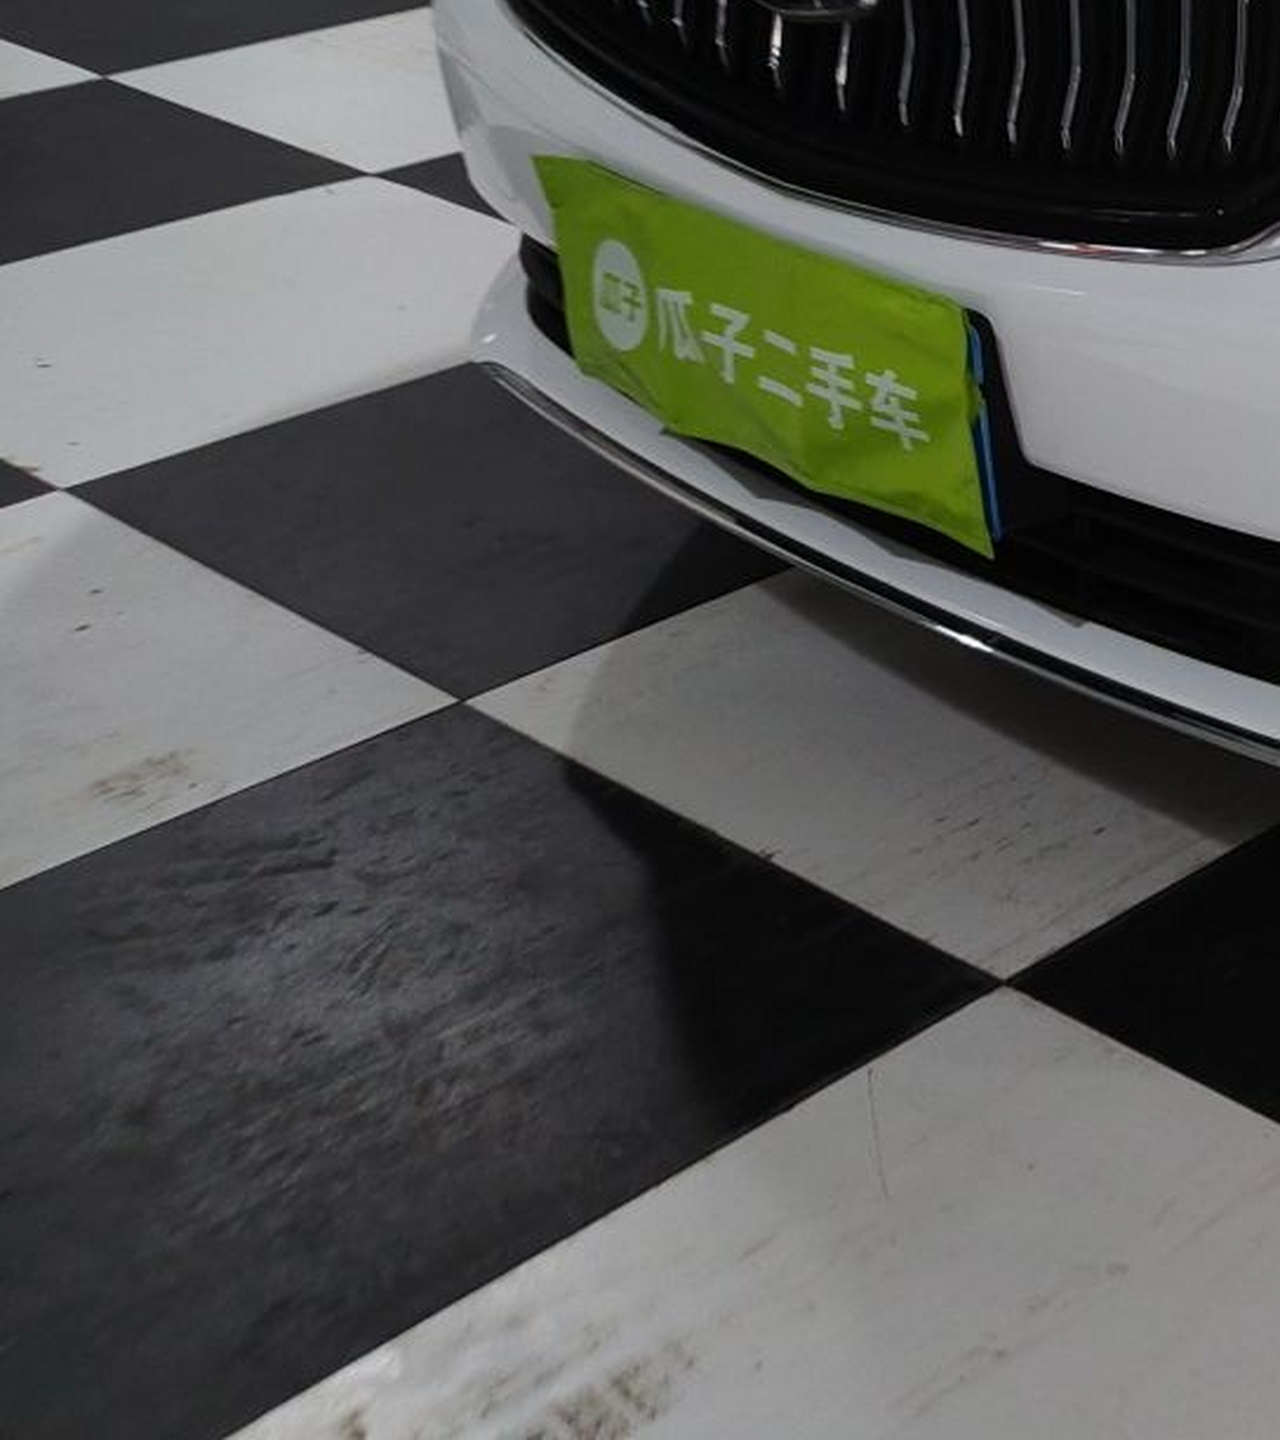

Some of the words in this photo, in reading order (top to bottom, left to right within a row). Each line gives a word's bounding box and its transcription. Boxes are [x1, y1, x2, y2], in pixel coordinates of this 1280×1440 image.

[655, 288, 930, 451] 瓜子二手车
